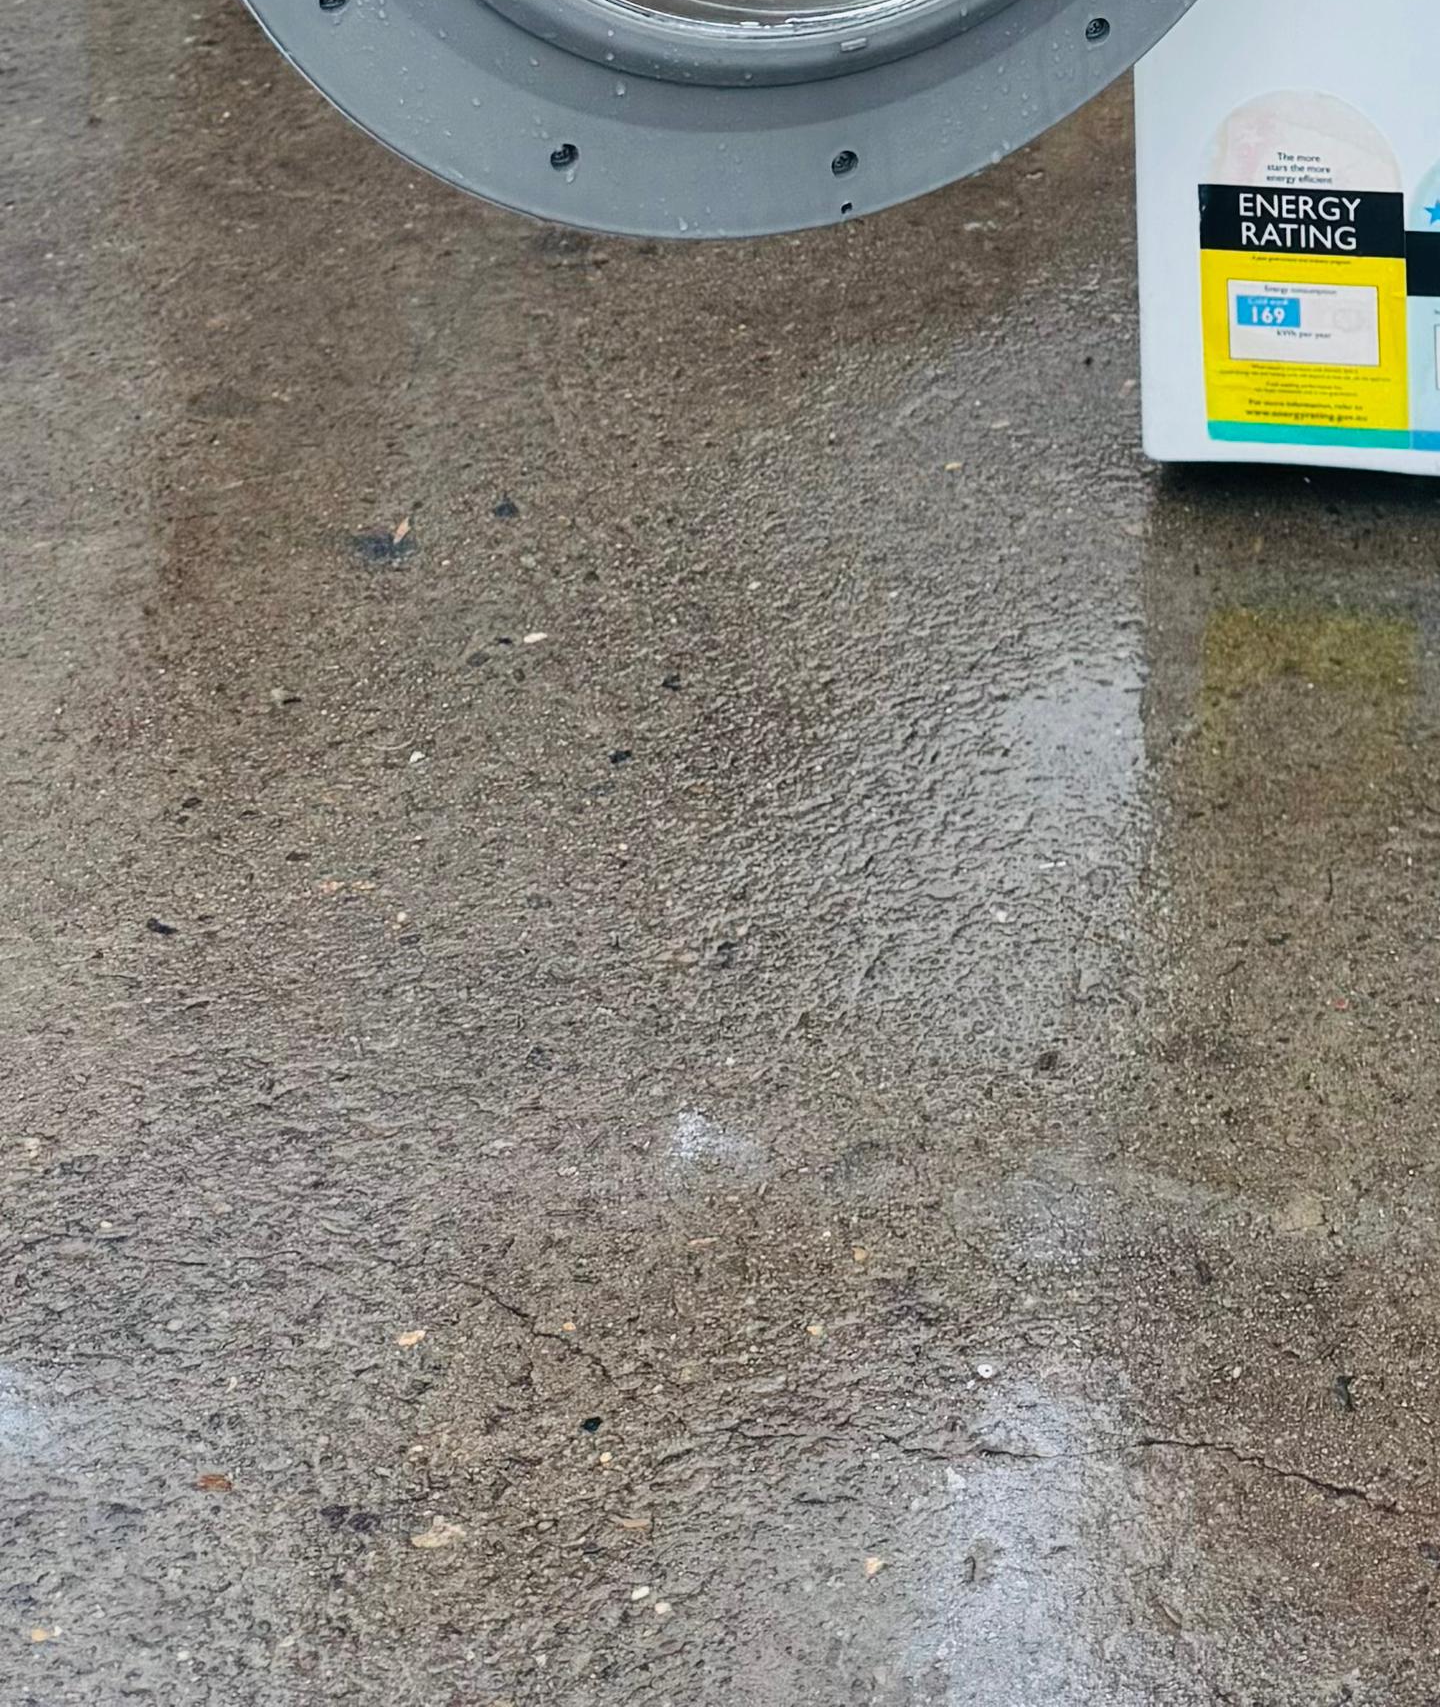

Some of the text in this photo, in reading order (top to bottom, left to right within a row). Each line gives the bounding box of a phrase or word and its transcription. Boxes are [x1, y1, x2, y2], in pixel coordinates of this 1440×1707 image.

[1277, 151, 1320, 162] The more
[1290, 163, 1304, 172] the
[1266, 174, 1332, 184] energy efficient
[1239, 193, 1361, 221] ENERGY
[1241, 222, 1357, 250] RATING
[1252, 306, 1285, 324] 169
